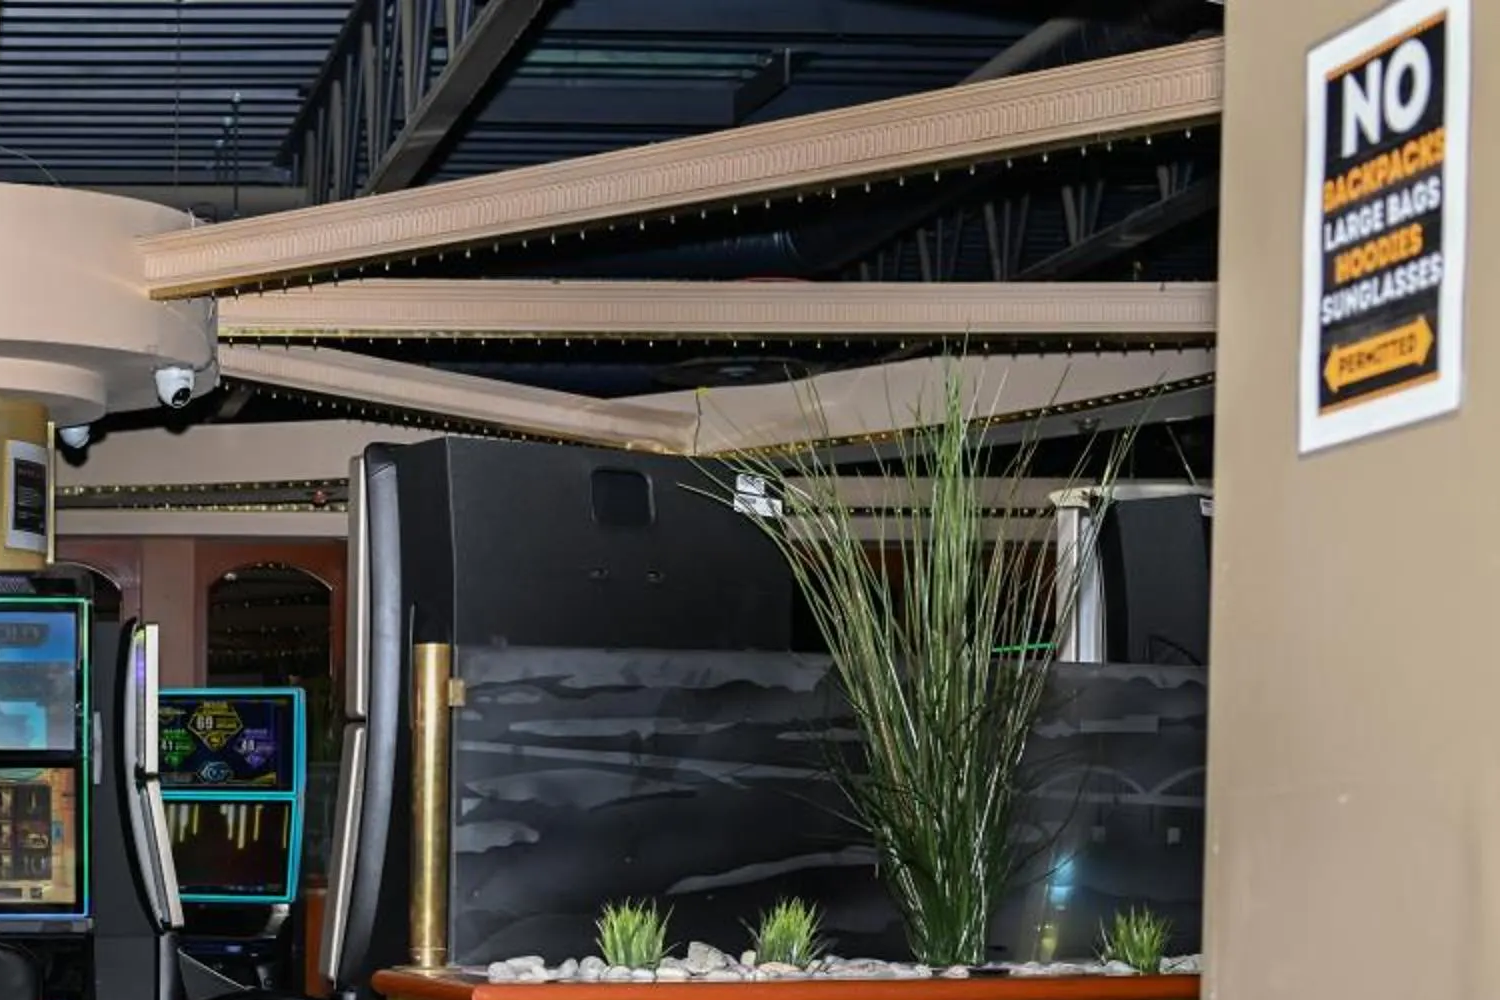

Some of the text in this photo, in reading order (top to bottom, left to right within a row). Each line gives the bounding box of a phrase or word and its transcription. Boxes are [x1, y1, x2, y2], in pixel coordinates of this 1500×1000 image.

[1341, 37, 1431, 158] NO
[1323, 128, 1445, 212] BACKPACKS
[1325, 176, 1440, 250] LARGE BAGS
[1322, 252, 1443, 325] SUNGLASSES
[1335, 223, 1423, 283] HOODIES
[1338, 331, 1417, 374] PERMITTED
